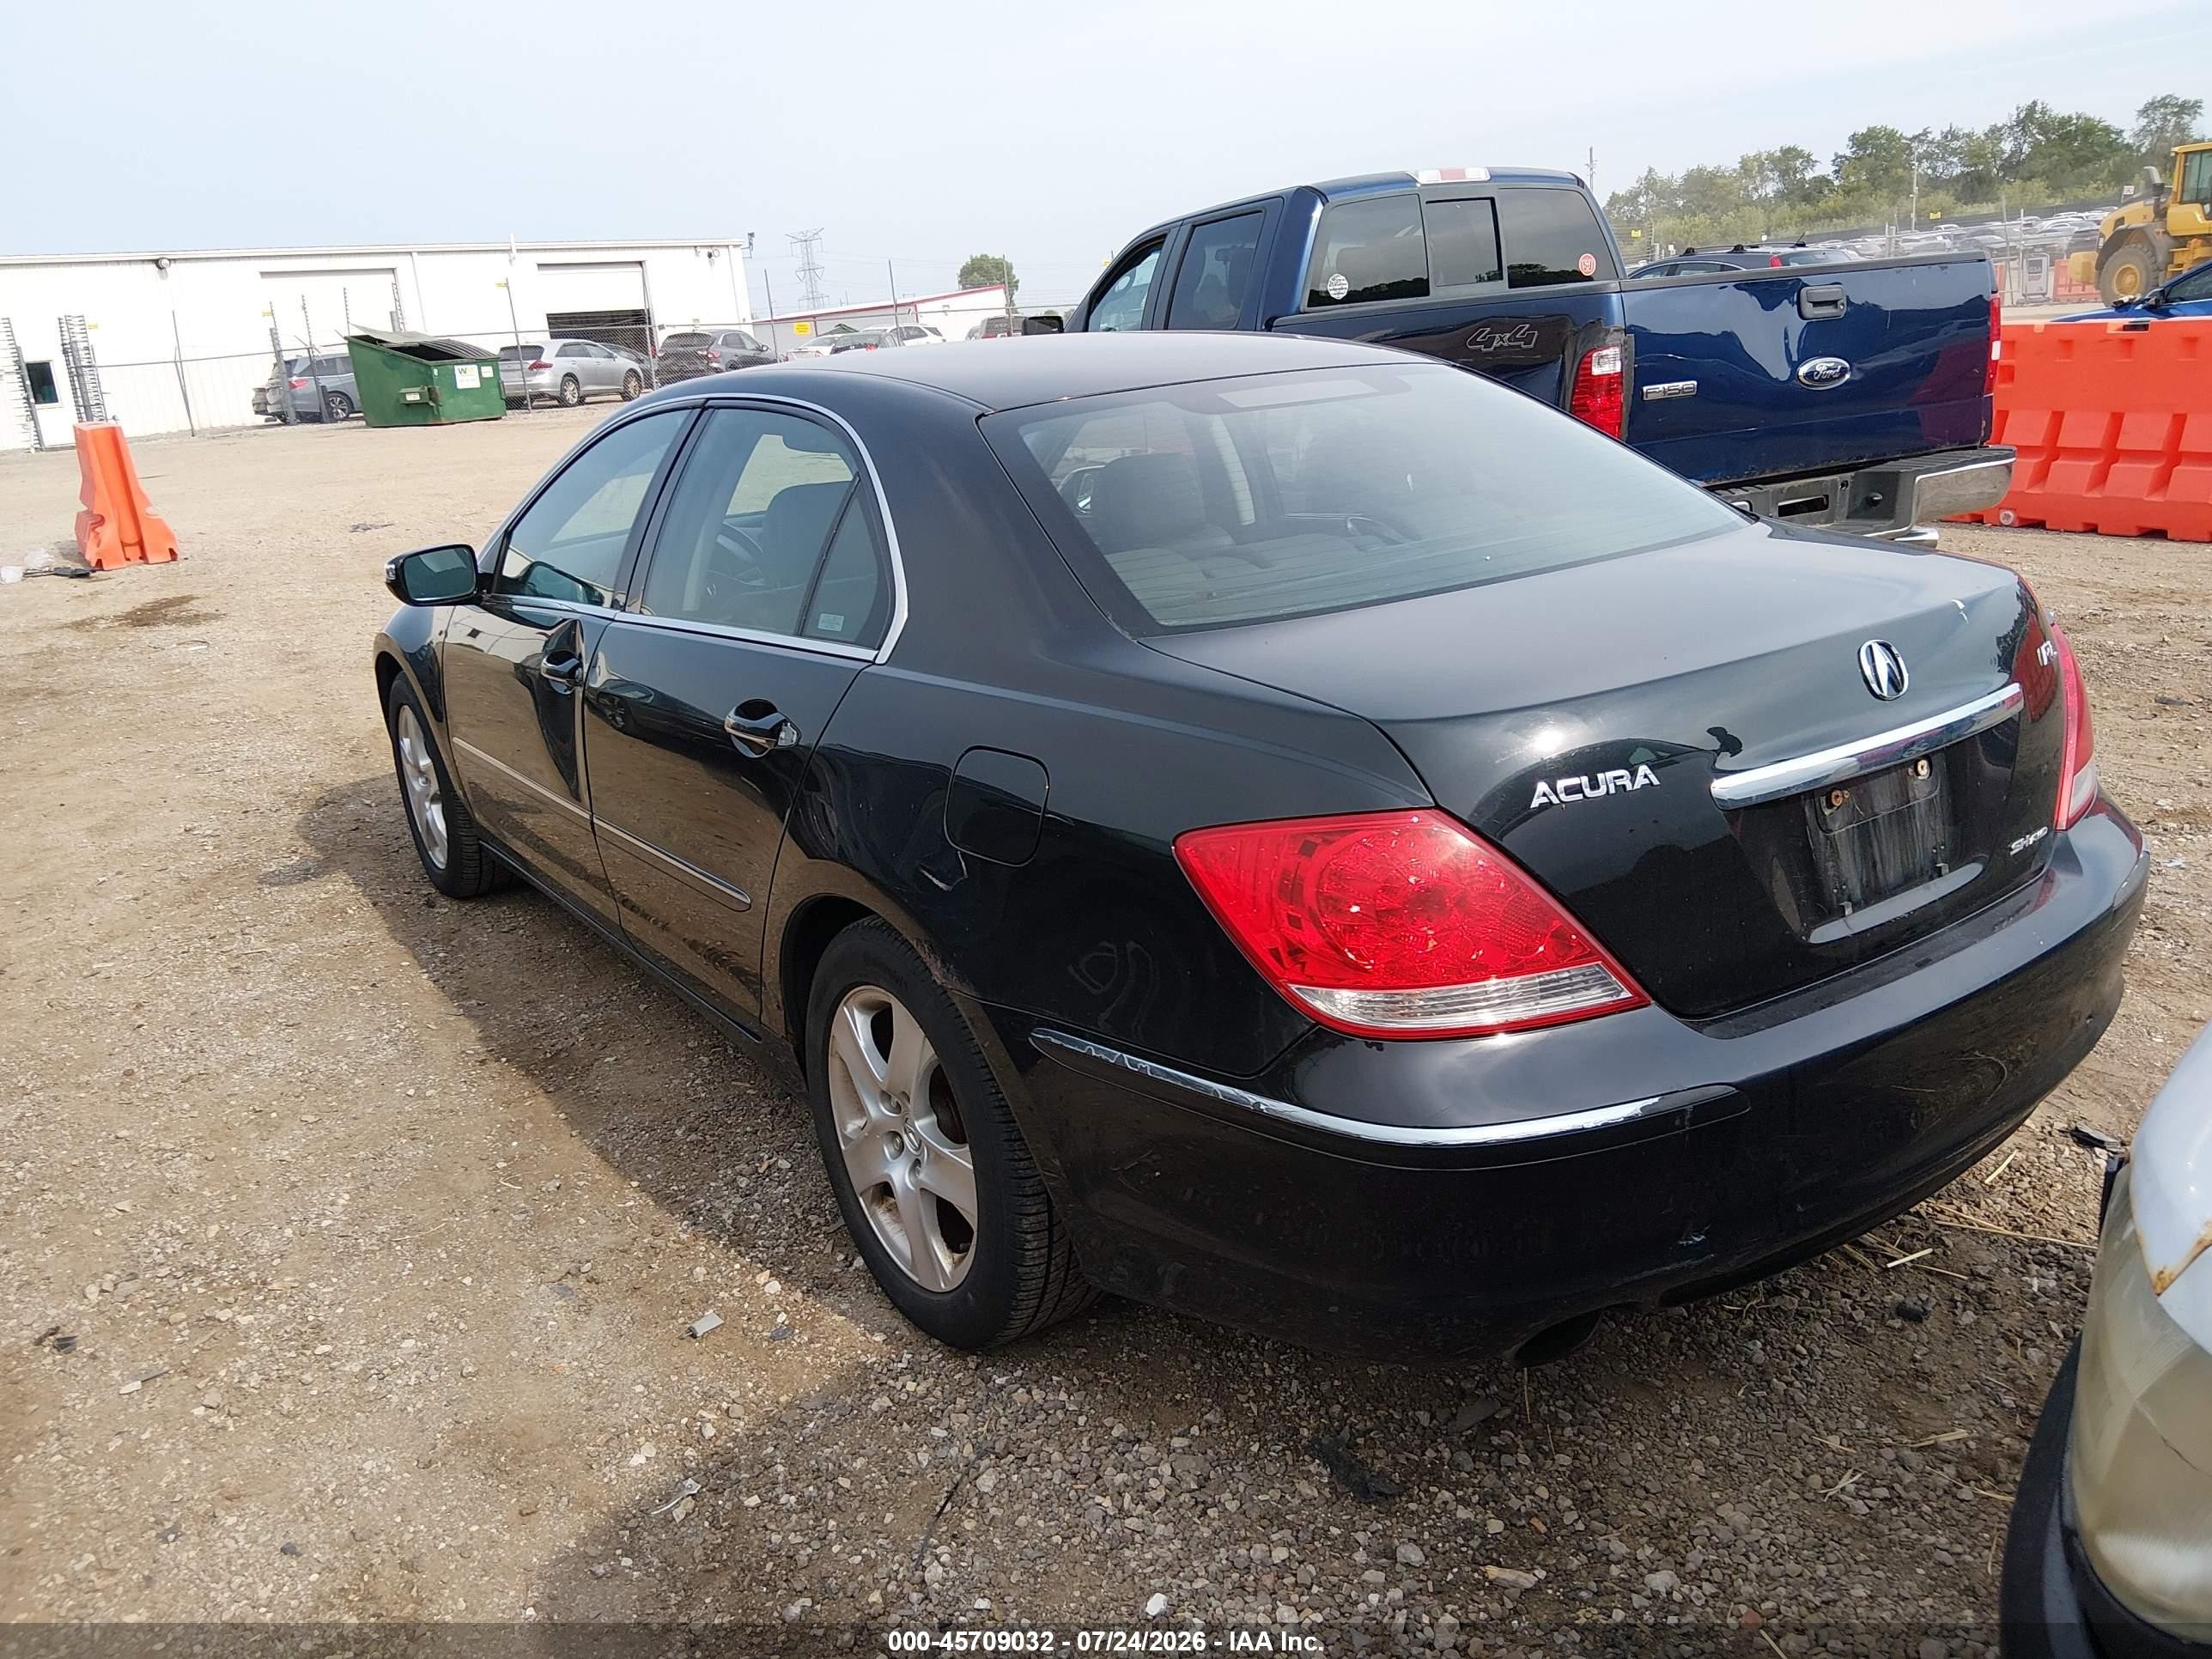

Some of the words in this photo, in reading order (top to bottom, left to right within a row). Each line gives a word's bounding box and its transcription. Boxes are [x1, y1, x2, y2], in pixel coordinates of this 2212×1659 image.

[1466, 324, 1538, 352] 4x4
[1814, 362, 1842, 380] Ford
[1644, 383, 1696, 399] F-150
[1529, 764, 1662, 809] ACURA
